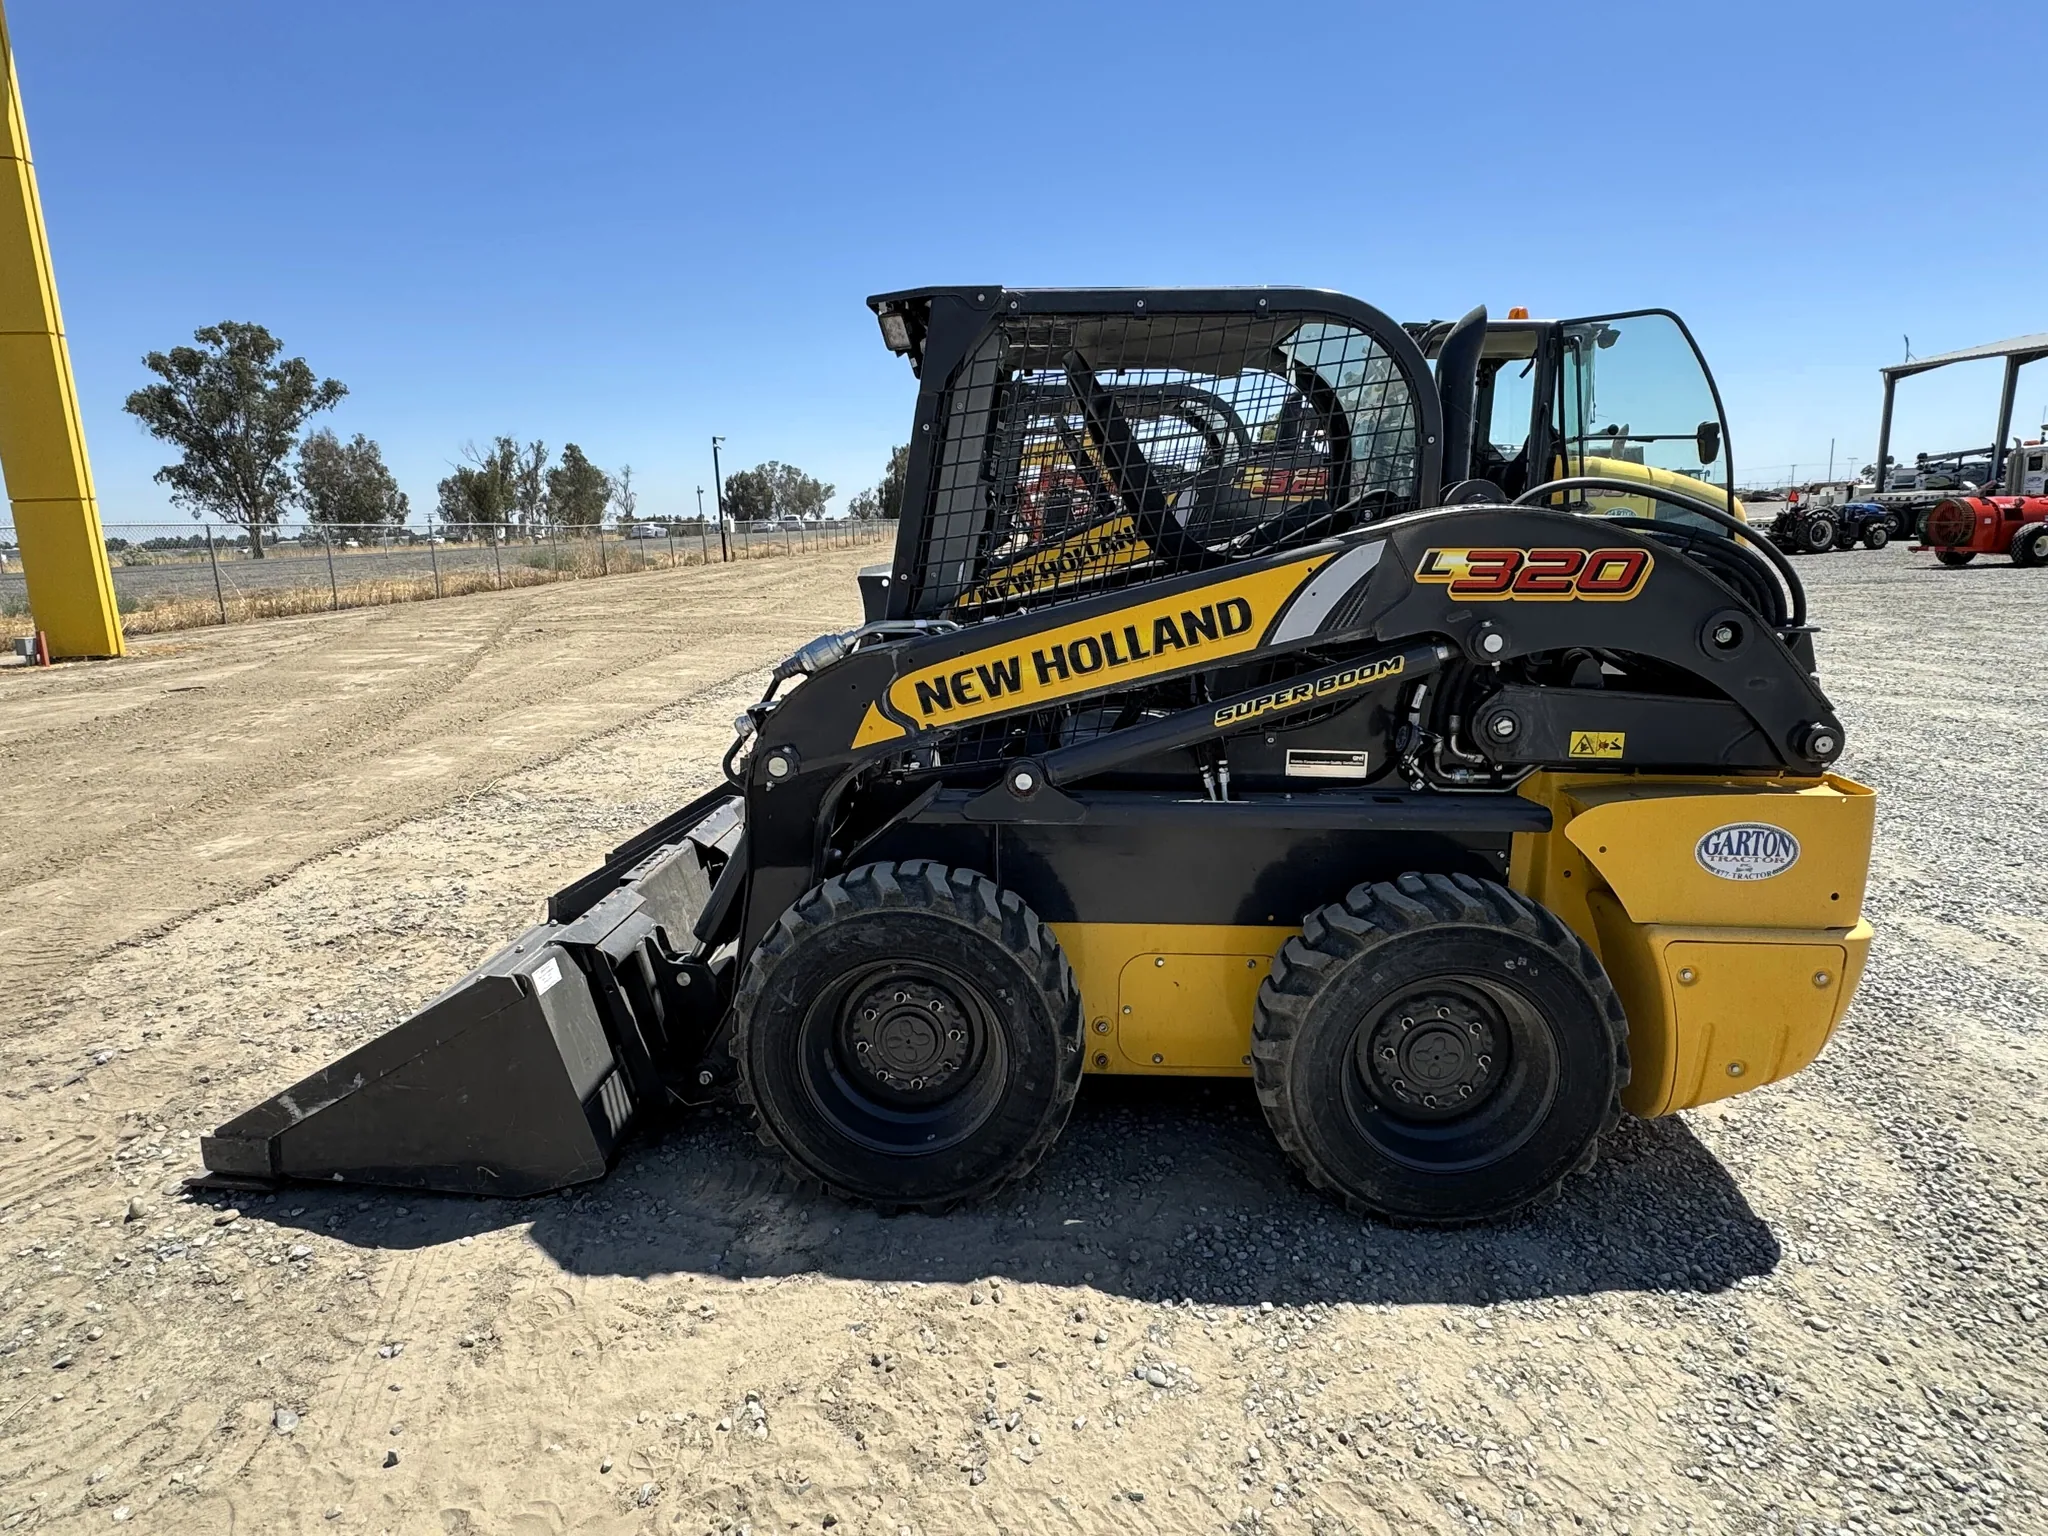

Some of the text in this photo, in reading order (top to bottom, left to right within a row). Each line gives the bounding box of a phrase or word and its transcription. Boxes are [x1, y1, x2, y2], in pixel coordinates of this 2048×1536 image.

[1414, 548, 1654, 600] L320
[914, 597, 1253, 716] NEW HOLLAND
[1215, 655, 1404, 727] SUPER BOOM
[1703, 830, 1791, 858] GARTON
[1707, 856, 1785, 864] TRACTOR
